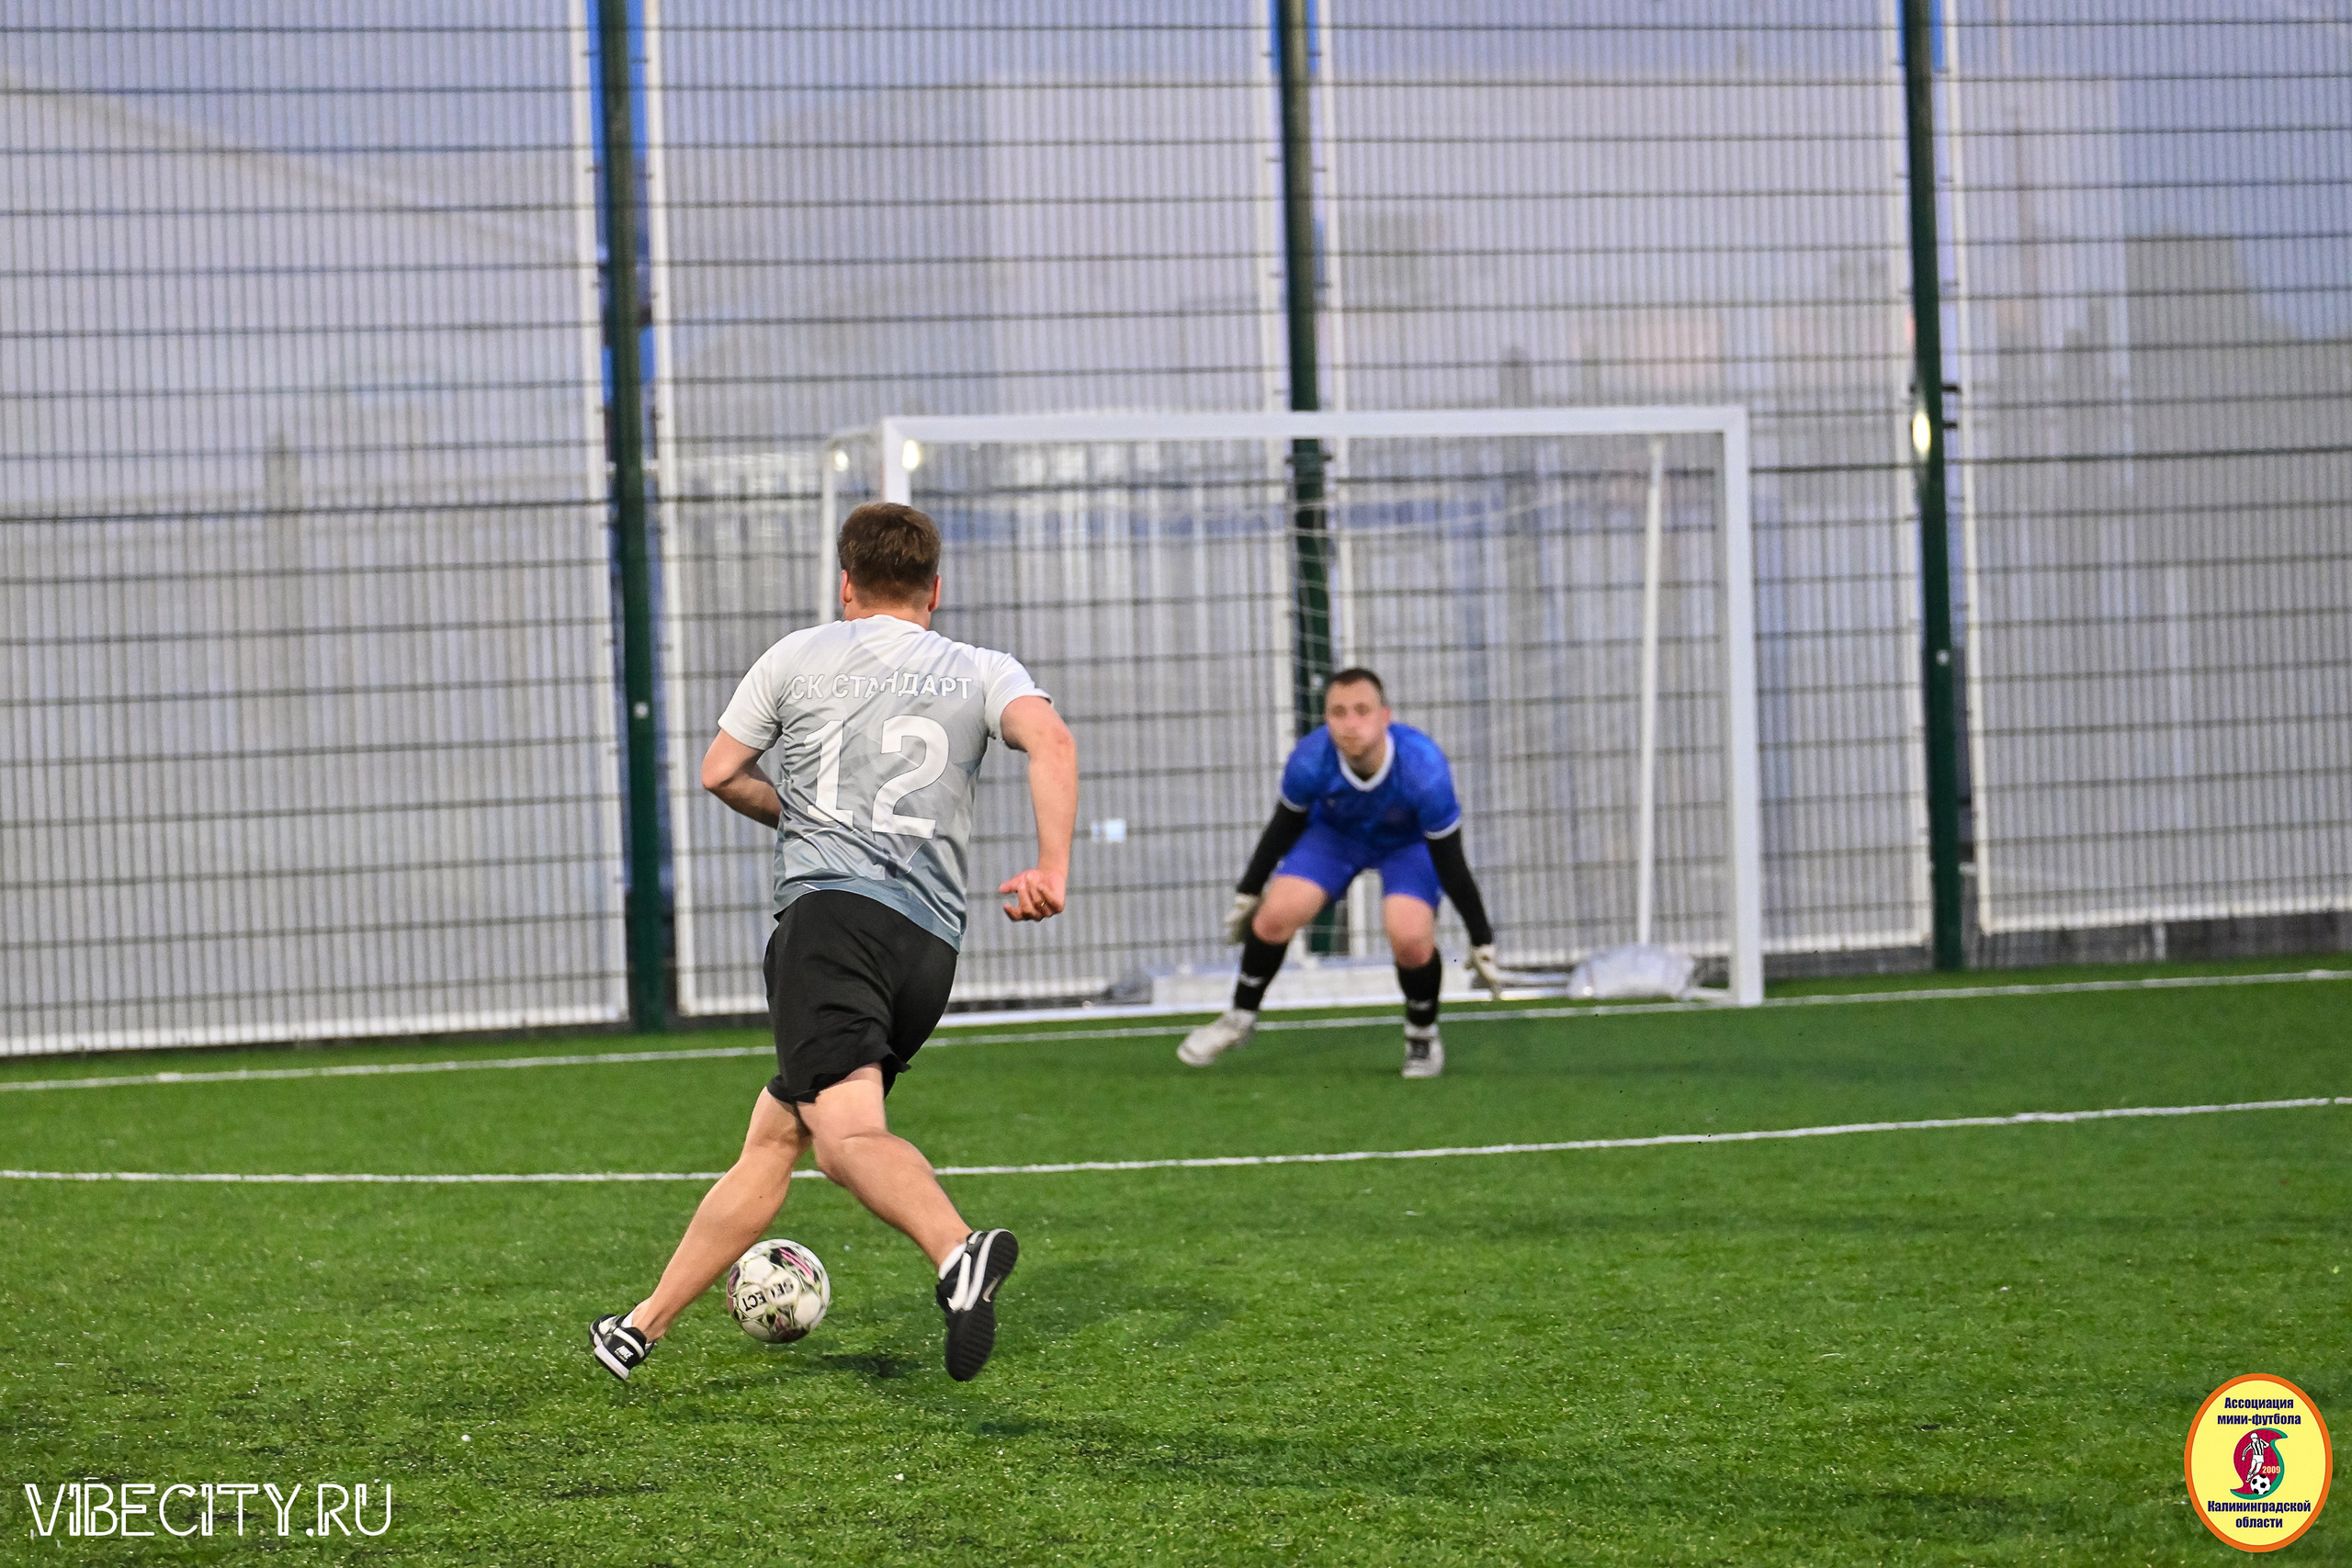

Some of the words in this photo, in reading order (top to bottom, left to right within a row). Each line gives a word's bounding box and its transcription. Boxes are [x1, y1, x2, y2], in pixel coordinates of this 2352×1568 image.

[791, 673, 825, 699] СК
[831, 671, 973, 699] СТАНДАРТ
[803, 714, 949, 840] 12
